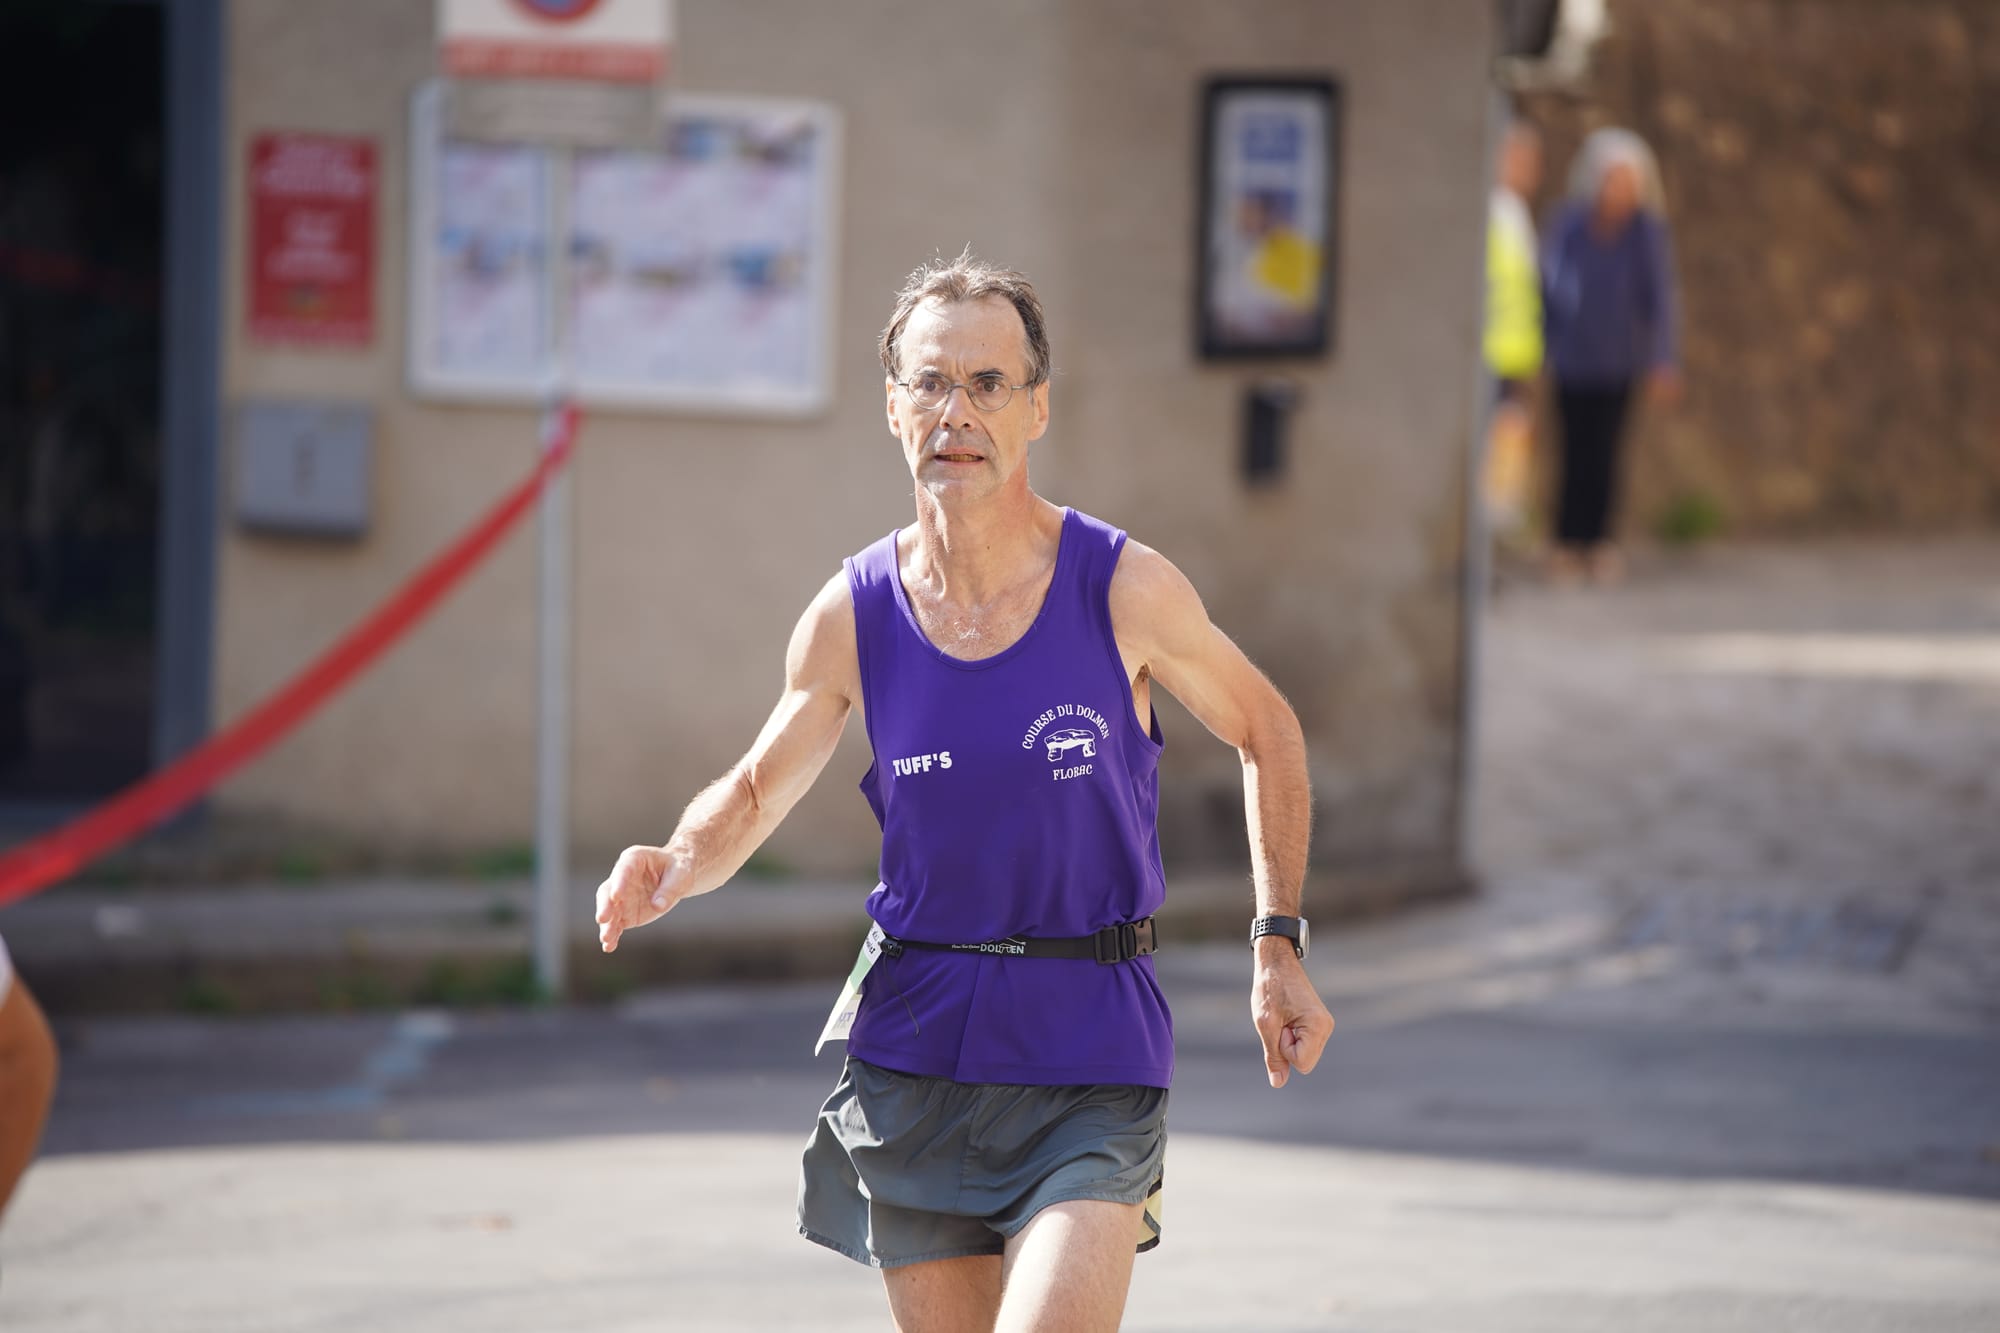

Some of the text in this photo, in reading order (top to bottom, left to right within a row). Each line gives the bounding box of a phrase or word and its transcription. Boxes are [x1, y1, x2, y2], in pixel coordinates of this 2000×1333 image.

[1022, 704, 1110, 750] COURSE DU DOLMEN
[892, 751, 953, 777] TUFF'S
[1053, 764, 1093, 780] FLORAC
